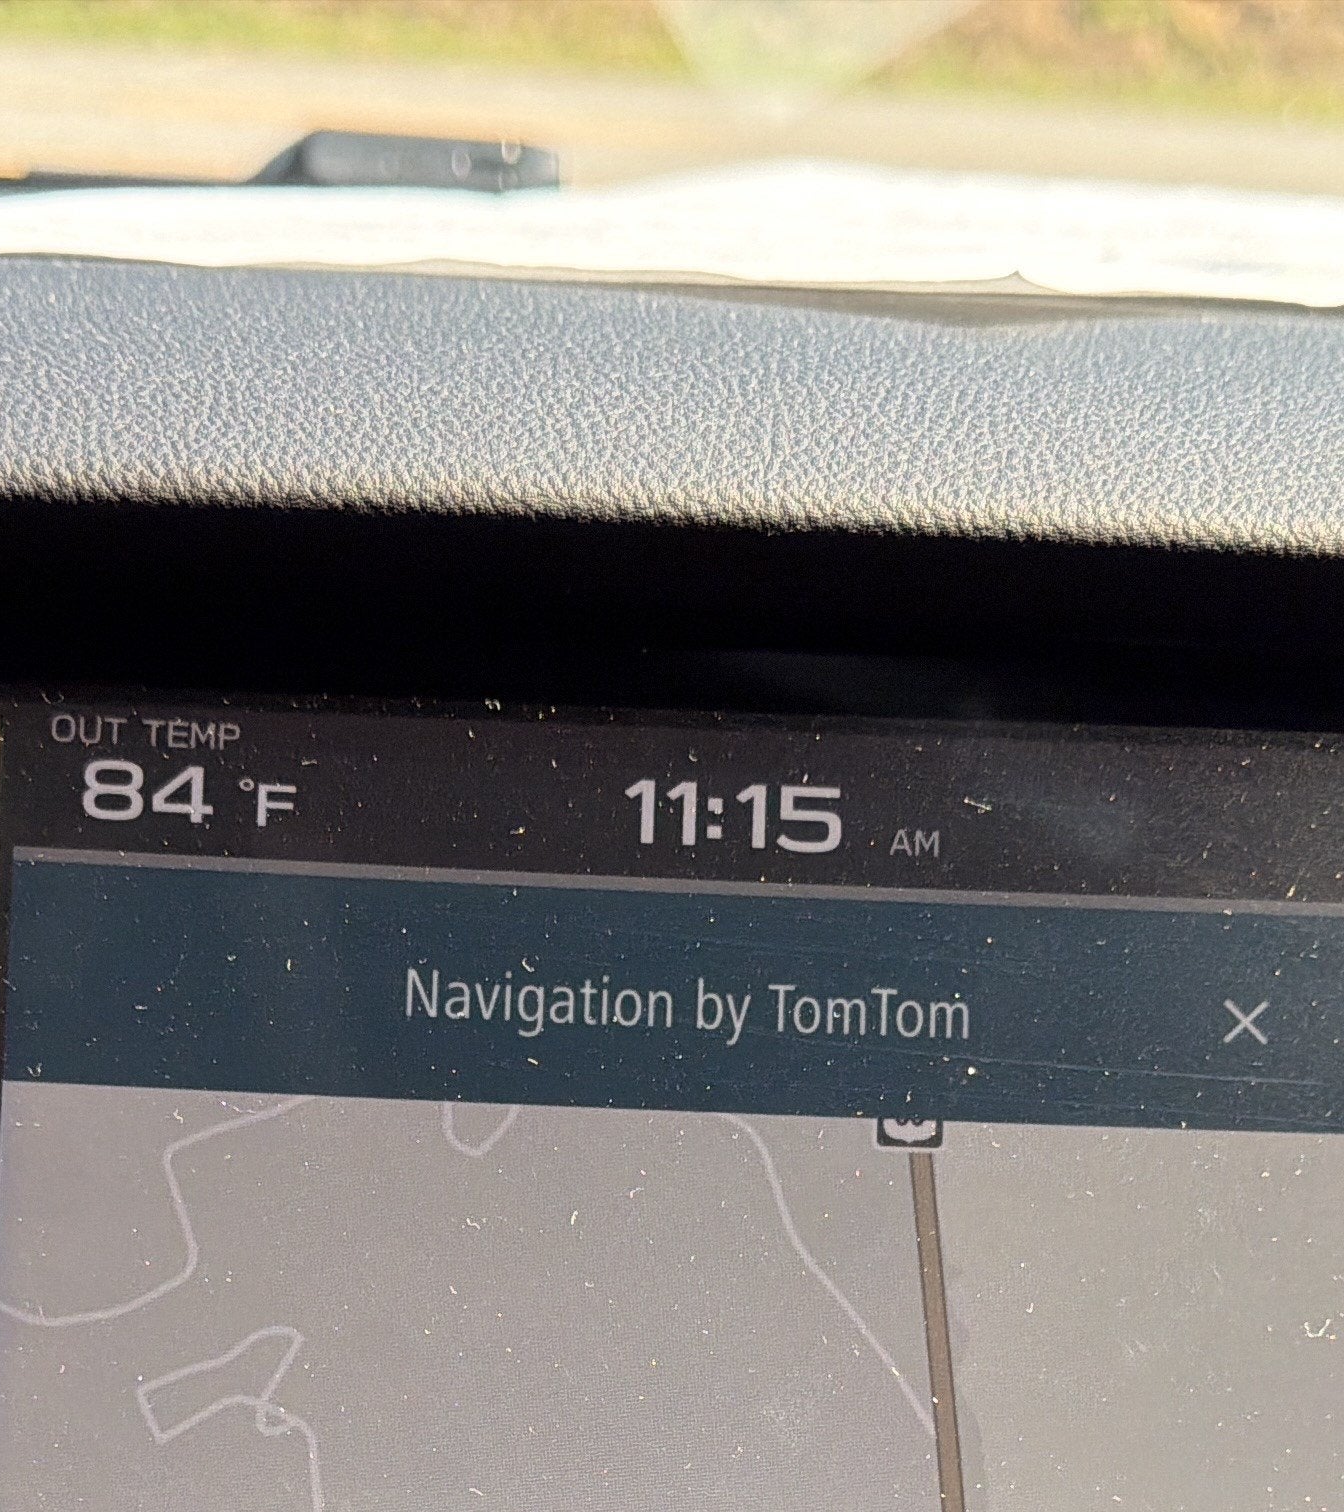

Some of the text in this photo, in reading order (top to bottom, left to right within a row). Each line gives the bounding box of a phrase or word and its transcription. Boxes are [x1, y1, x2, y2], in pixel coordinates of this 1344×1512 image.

[51, 714, 241, 750] OUT TEMP
[82, 759, 213, 824] 84
[624, 778, 941, 857] 11:15 AM
[405, 968, 970, 1044] Navigation by TomTom
